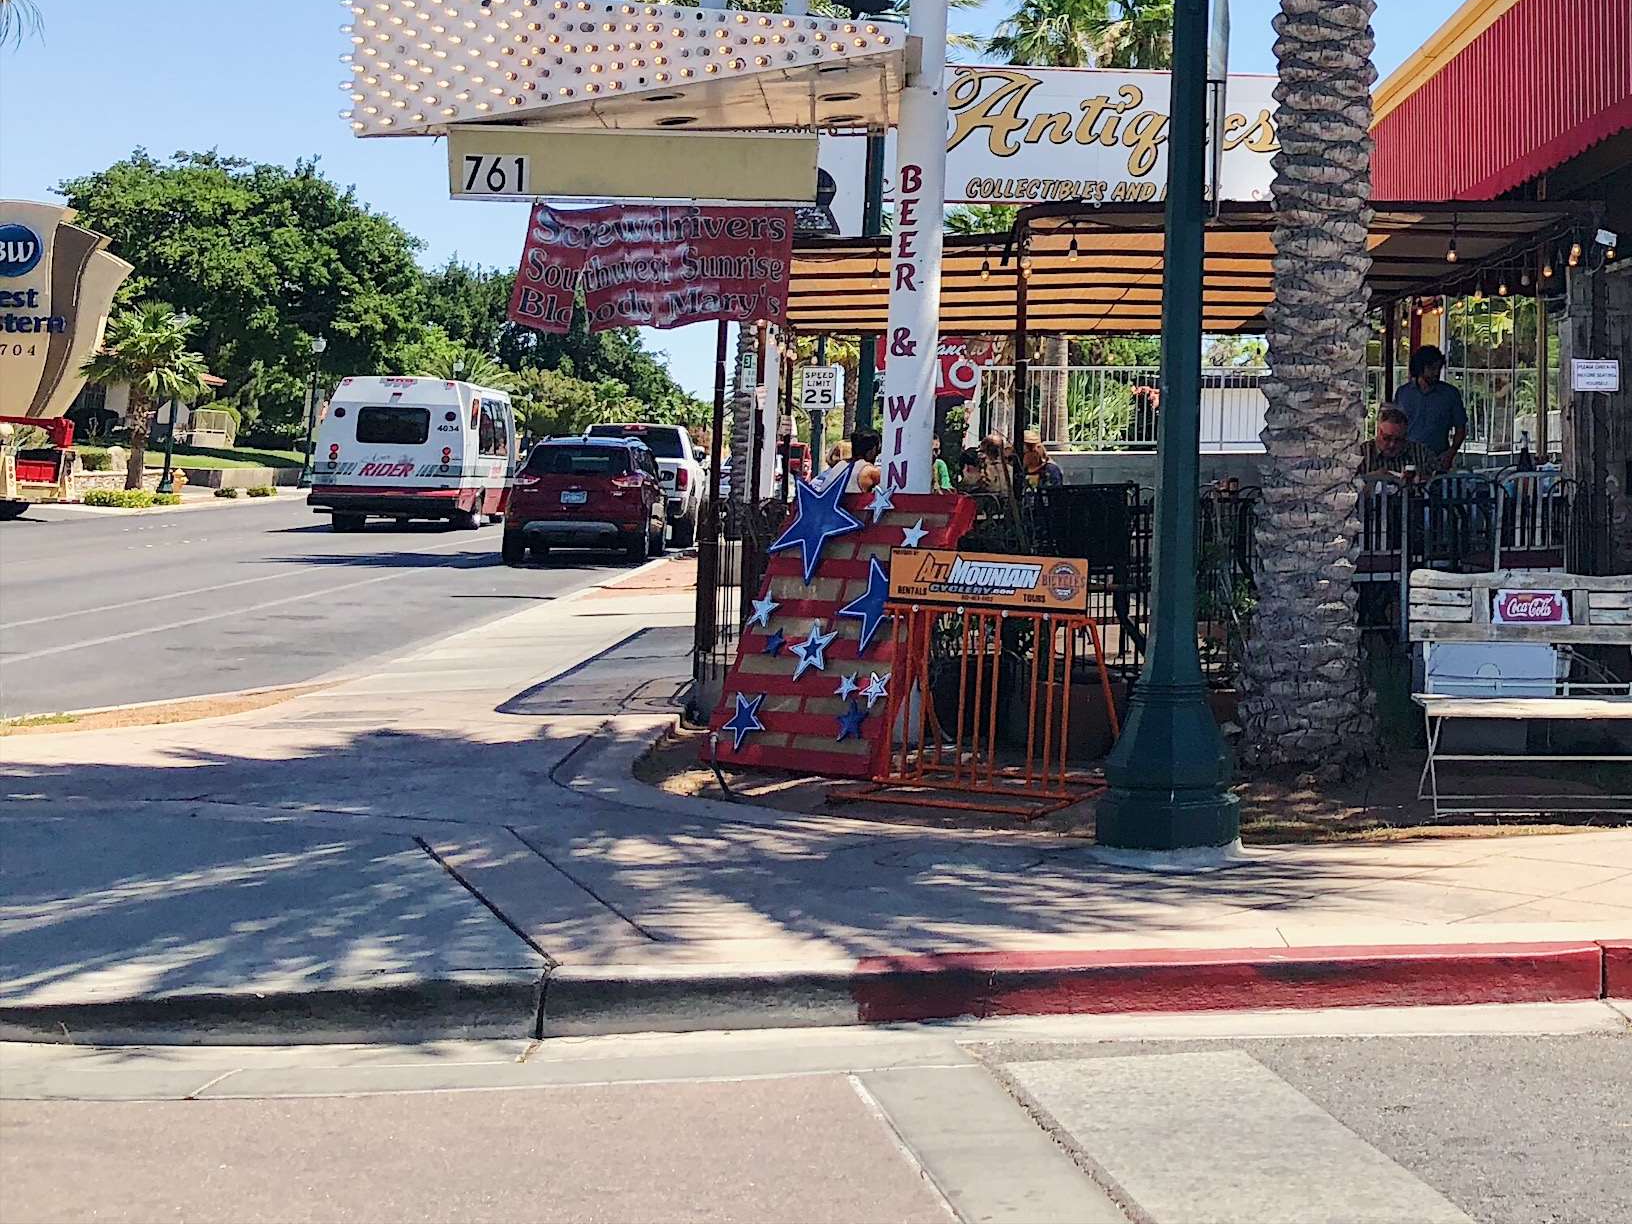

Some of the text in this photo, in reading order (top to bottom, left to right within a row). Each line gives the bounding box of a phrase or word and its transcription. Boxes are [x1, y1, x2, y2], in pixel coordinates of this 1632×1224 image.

[946, 67, 1281, 176] Antiqes
[465, 156, 525, 192] 761
[966, 176, 1108, 201] COLLECTIBLES
[1111, 181, 1157, 201] AND
[533, 206, 786, 248] Screwdrivers
[894, 164, 922, 292] BEER
[526, 243, 785, 293] Southwest Sunrise
[665, 283, 781, 319] Mary's
[0, 344, 36, 356] 704
[890, 327, 916, 357] &
[804, 371, 834, 379] SPEED
[804, 389, 832, 404] 25
[437, 424, 460, 432] 4034
[358, 463, 415, 477] RIDER
